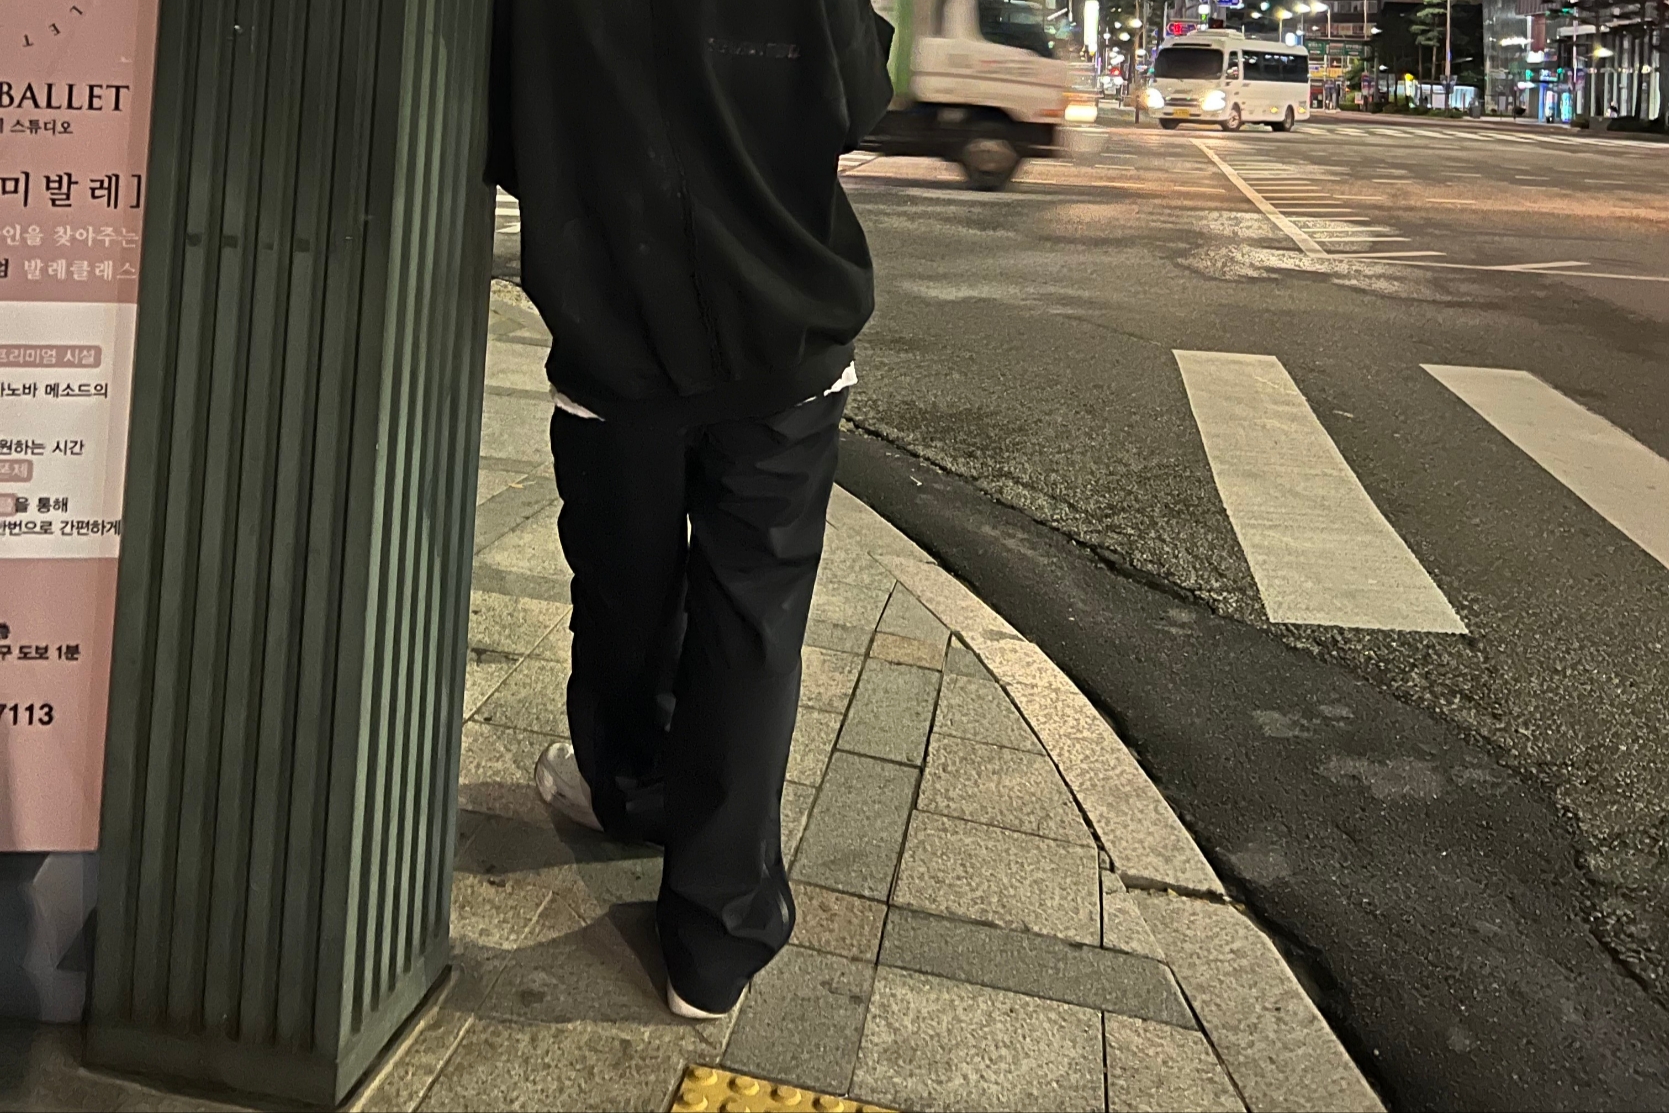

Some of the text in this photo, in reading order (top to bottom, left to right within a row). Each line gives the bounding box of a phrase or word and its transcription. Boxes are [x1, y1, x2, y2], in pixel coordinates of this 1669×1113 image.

[0, 81, 130, 112] BALLET
[10, 118, 74, 136] 스튜디오
[53, 225, 139, 248] 찾아주는
[63, 348, 95, 365] 시설
[44, 382, 109, 399] 메소드의
[0, 439, 85, 456] 원하는 시간
[36, 496, 69, 514] 통해
[59, 519, 123, 537] 간편하게
[17, 644, 49, 661] 도보
